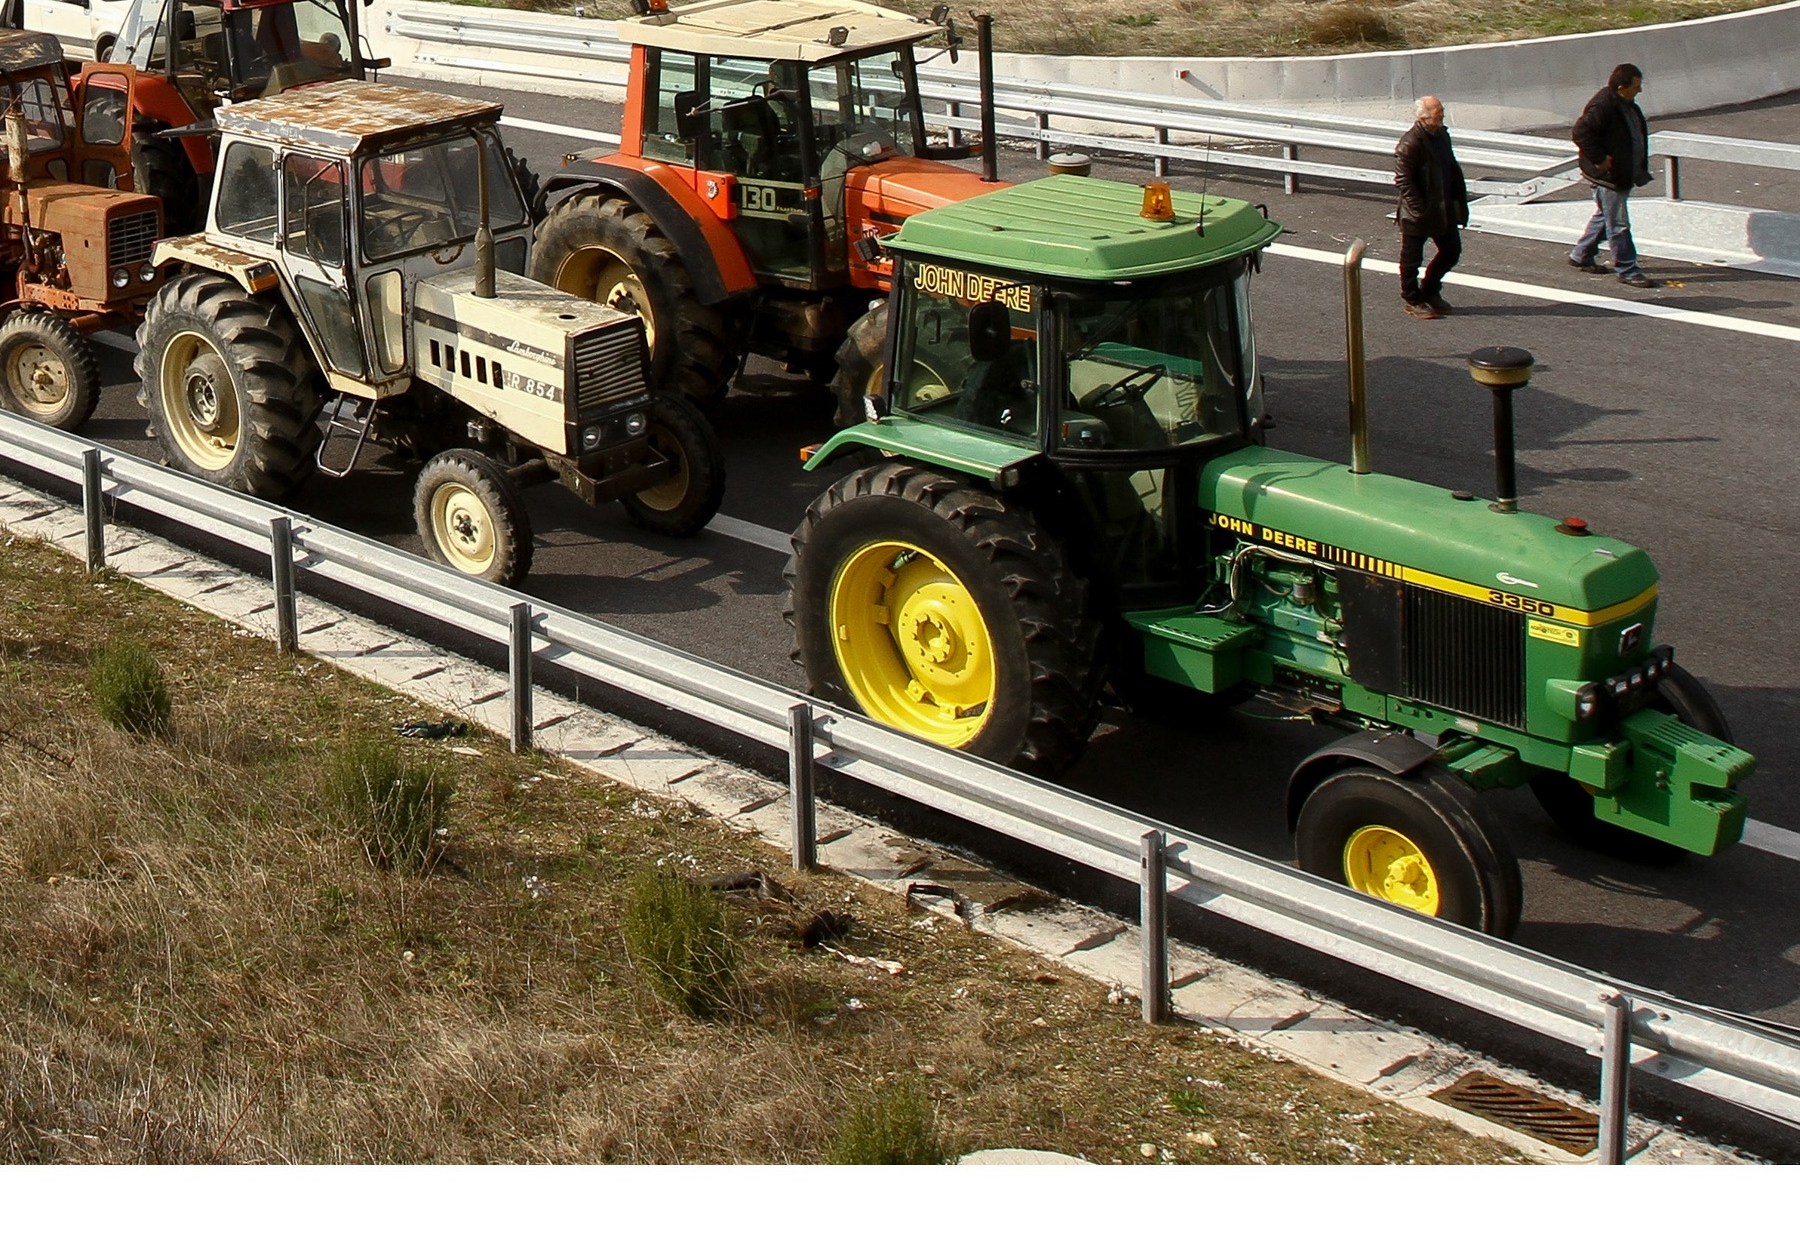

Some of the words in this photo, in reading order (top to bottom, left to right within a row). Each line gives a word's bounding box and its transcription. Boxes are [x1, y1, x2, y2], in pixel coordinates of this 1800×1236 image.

[741, 185, 776, 211] 130
[914, 264, 964, 298] JOHN
[967, 273, 1031, 313] DEERE
[506, 340, 557, 366] Lamborghini
[526, 378, 555, 401] 854
[1209, 513, 1253, 536] JOHN
[1262, 527, 1317, 555] DEERE
[1489, 590, 1554, 617] 3350
